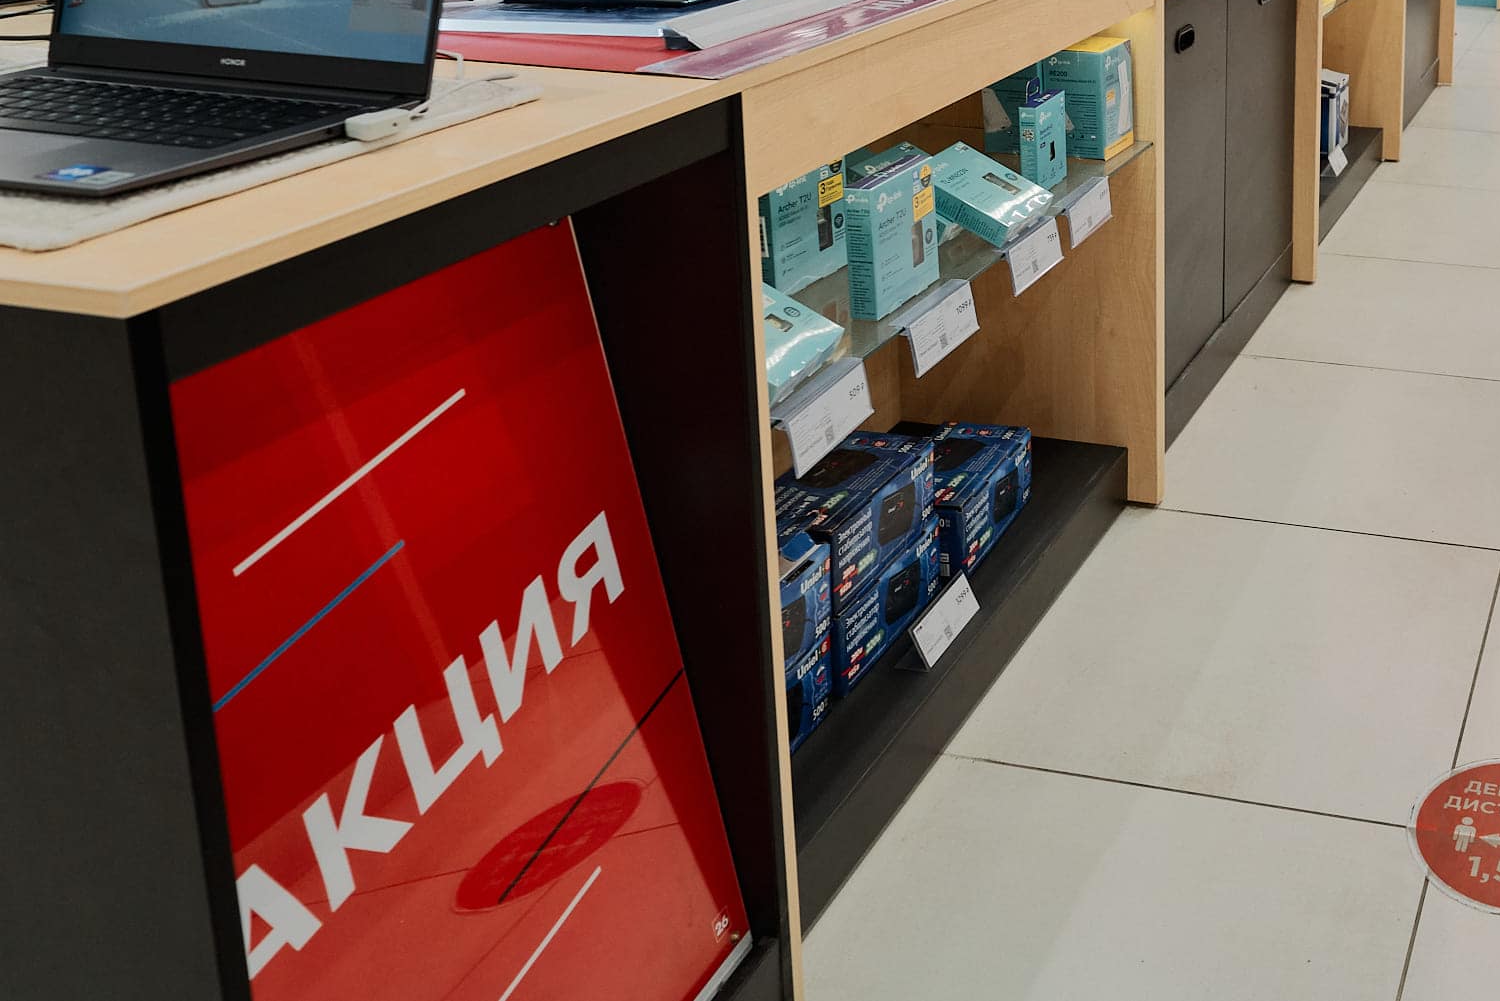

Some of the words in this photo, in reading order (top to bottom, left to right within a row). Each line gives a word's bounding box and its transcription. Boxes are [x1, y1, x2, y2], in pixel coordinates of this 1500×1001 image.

[819, 183, 826, 195] 3
[777, 198, 799, 214] Archer
[799, 192, 812, 205] T2U
[879, 219, 896, 231] Archer
[910, 456, 928, 480] Uniel
[915, 534, 933, 558] Uniel
[800, 565, 822, 594] Uniel
[797, 650, 819, 680] Uniel
[237, 511, 626, 980] АКЦИЯ
